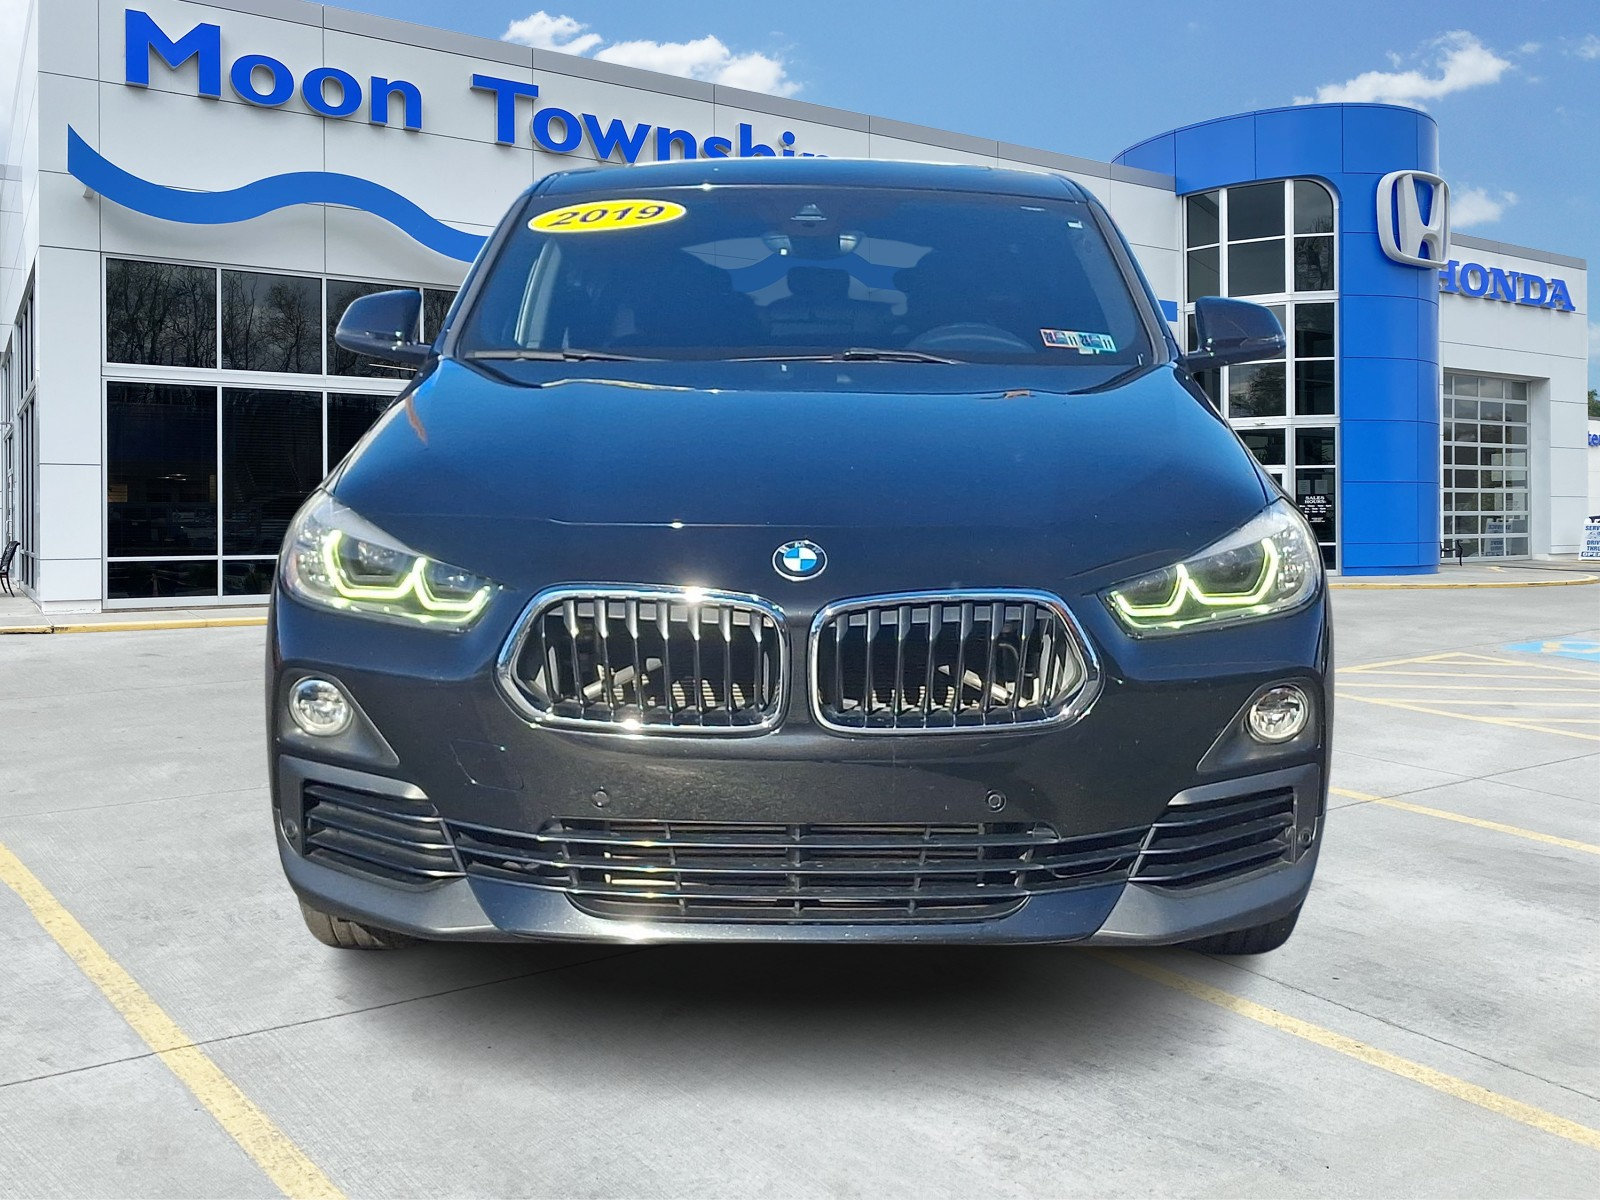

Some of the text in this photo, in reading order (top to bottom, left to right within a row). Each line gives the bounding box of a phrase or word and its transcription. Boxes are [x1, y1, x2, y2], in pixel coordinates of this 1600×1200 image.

[124, 8, 831, 163] Moon Townsh
[547, 205, 666, 227] 2019
[1439, 259, 1576, 312] HONDA
